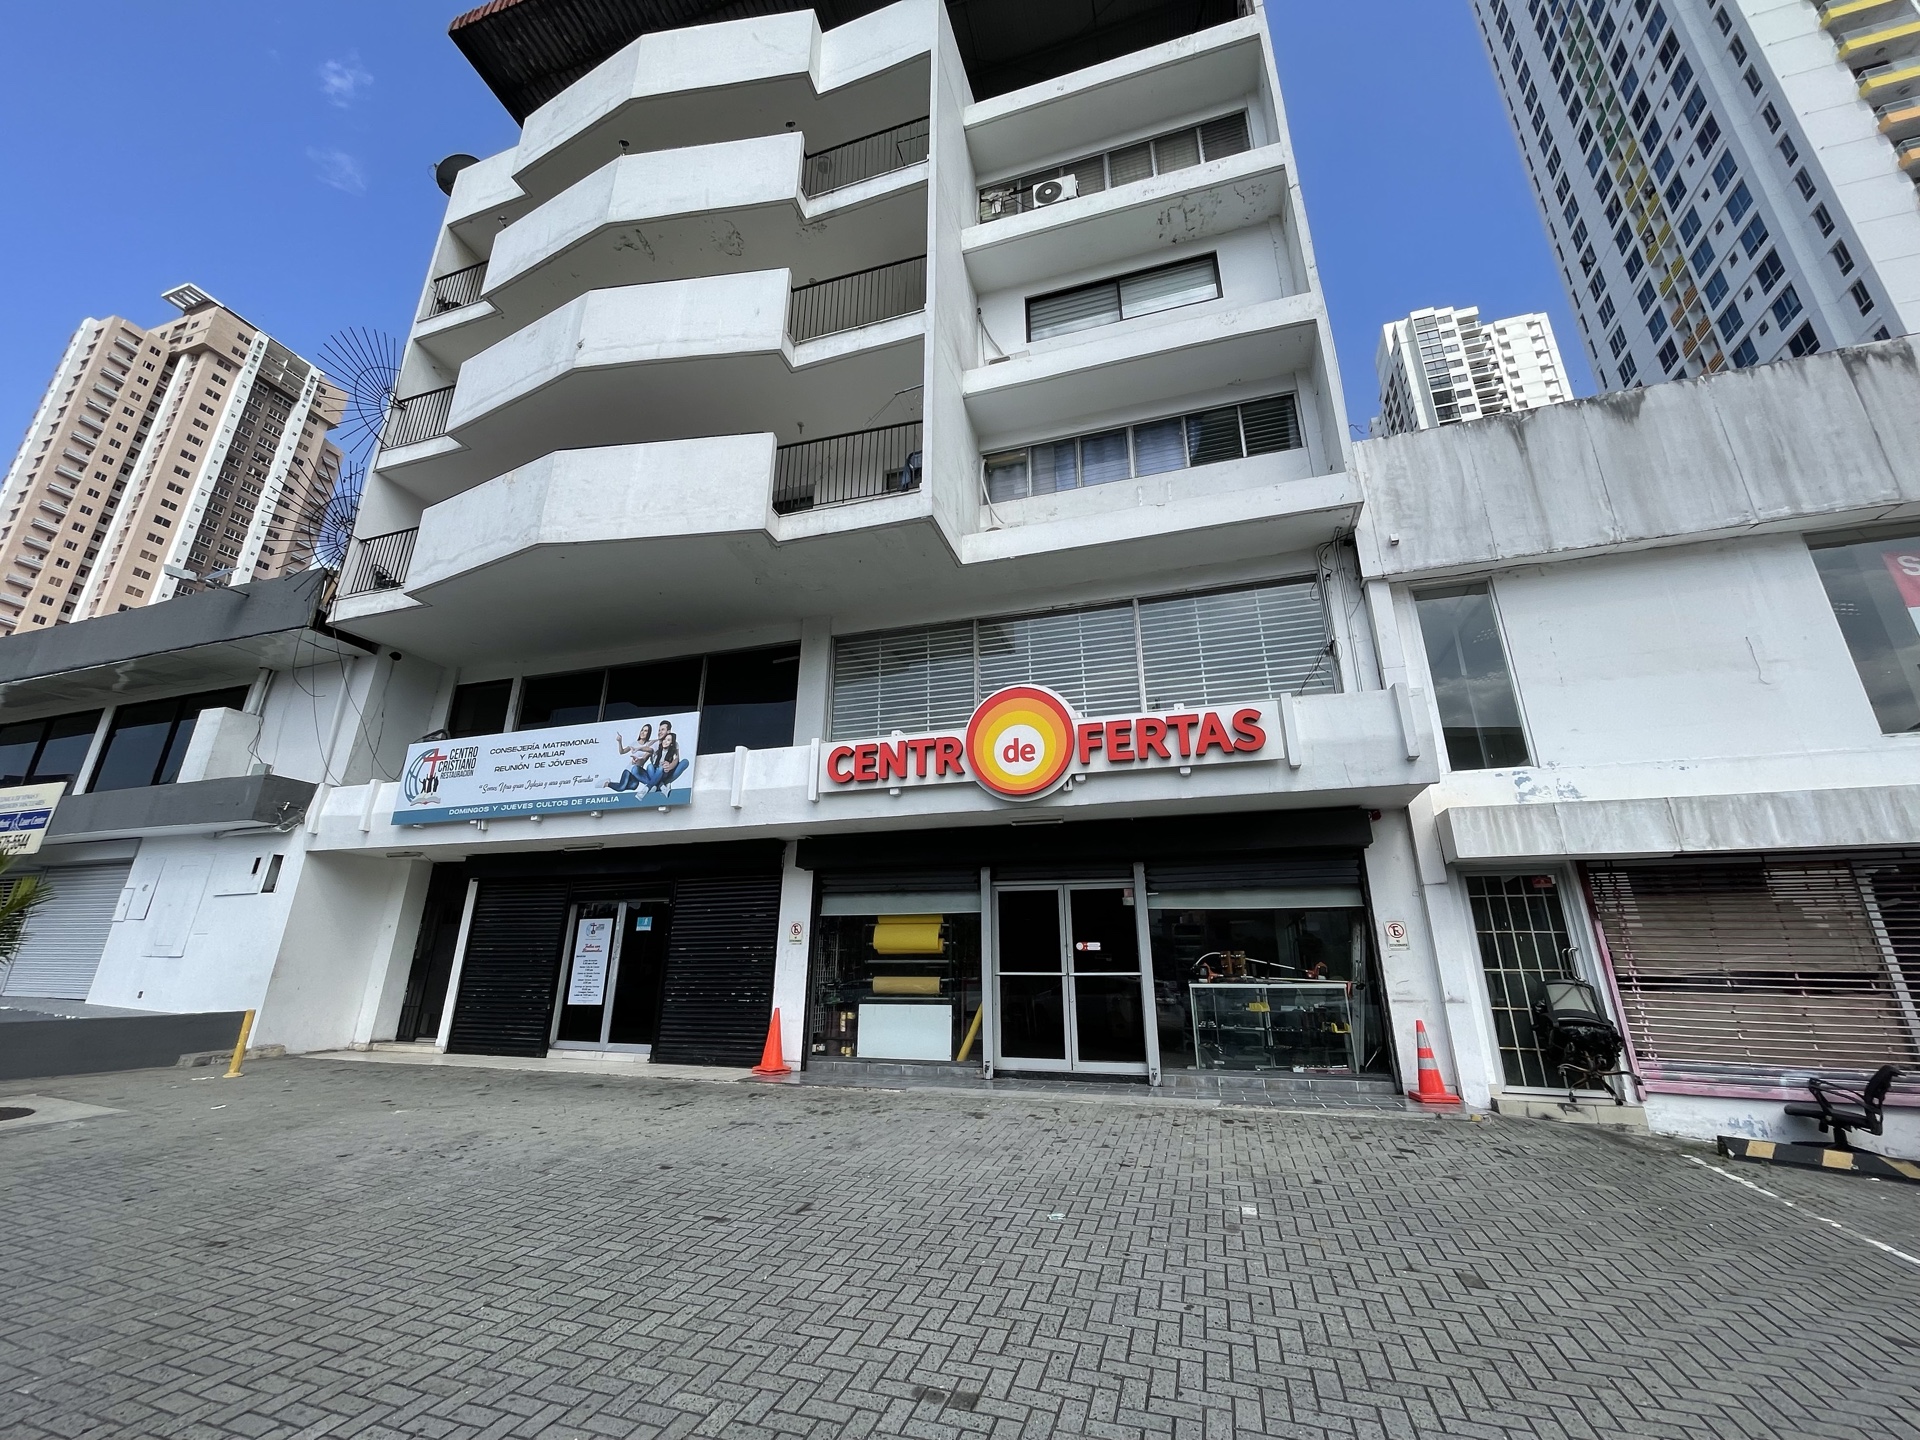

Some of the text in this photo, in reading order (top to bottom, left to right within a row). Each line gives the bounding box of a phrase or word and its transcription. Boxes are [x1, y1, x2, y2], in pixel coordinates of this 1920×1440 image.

[449, 746, 479, 760] CENTRO
[489, 738, 600, 755] CONSEJERÍA MATRIMONIAL
[1003, 737, 1035, 764] de
[527, 750, 566, 760] FAMILIAR
[438, 757, 477, 772] CRISTIANO
[494, 758, 588, 772] REUNIÓN DE JÓVENES
[448, 806, 490, 816] DOMINGOS
[500, 802, 533, 811] JUEVES
[536, 800, 569, 808] CULTOS
[571, 798, 582, 806] DE
[585, 795, 620, 804] FAMILIA
